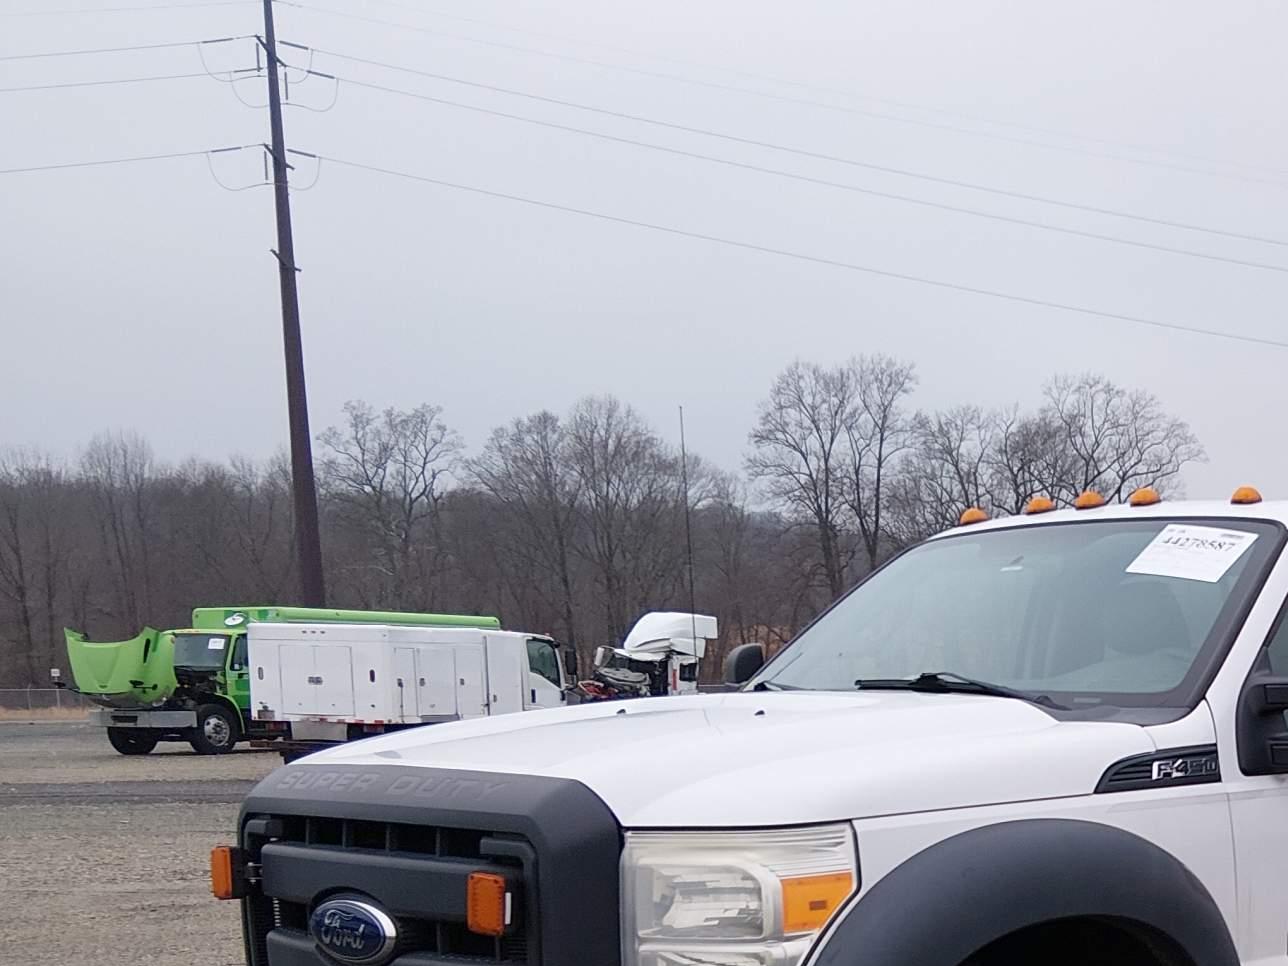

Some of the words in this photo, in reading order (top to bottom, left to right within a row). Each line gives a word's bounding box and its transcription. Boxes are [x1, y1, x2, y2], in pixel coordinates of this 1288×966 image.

[277, 771, 380, 793] SUPER
[386, 775, 508, 800] DUTY
[321, 909, 366, 950] Ford
